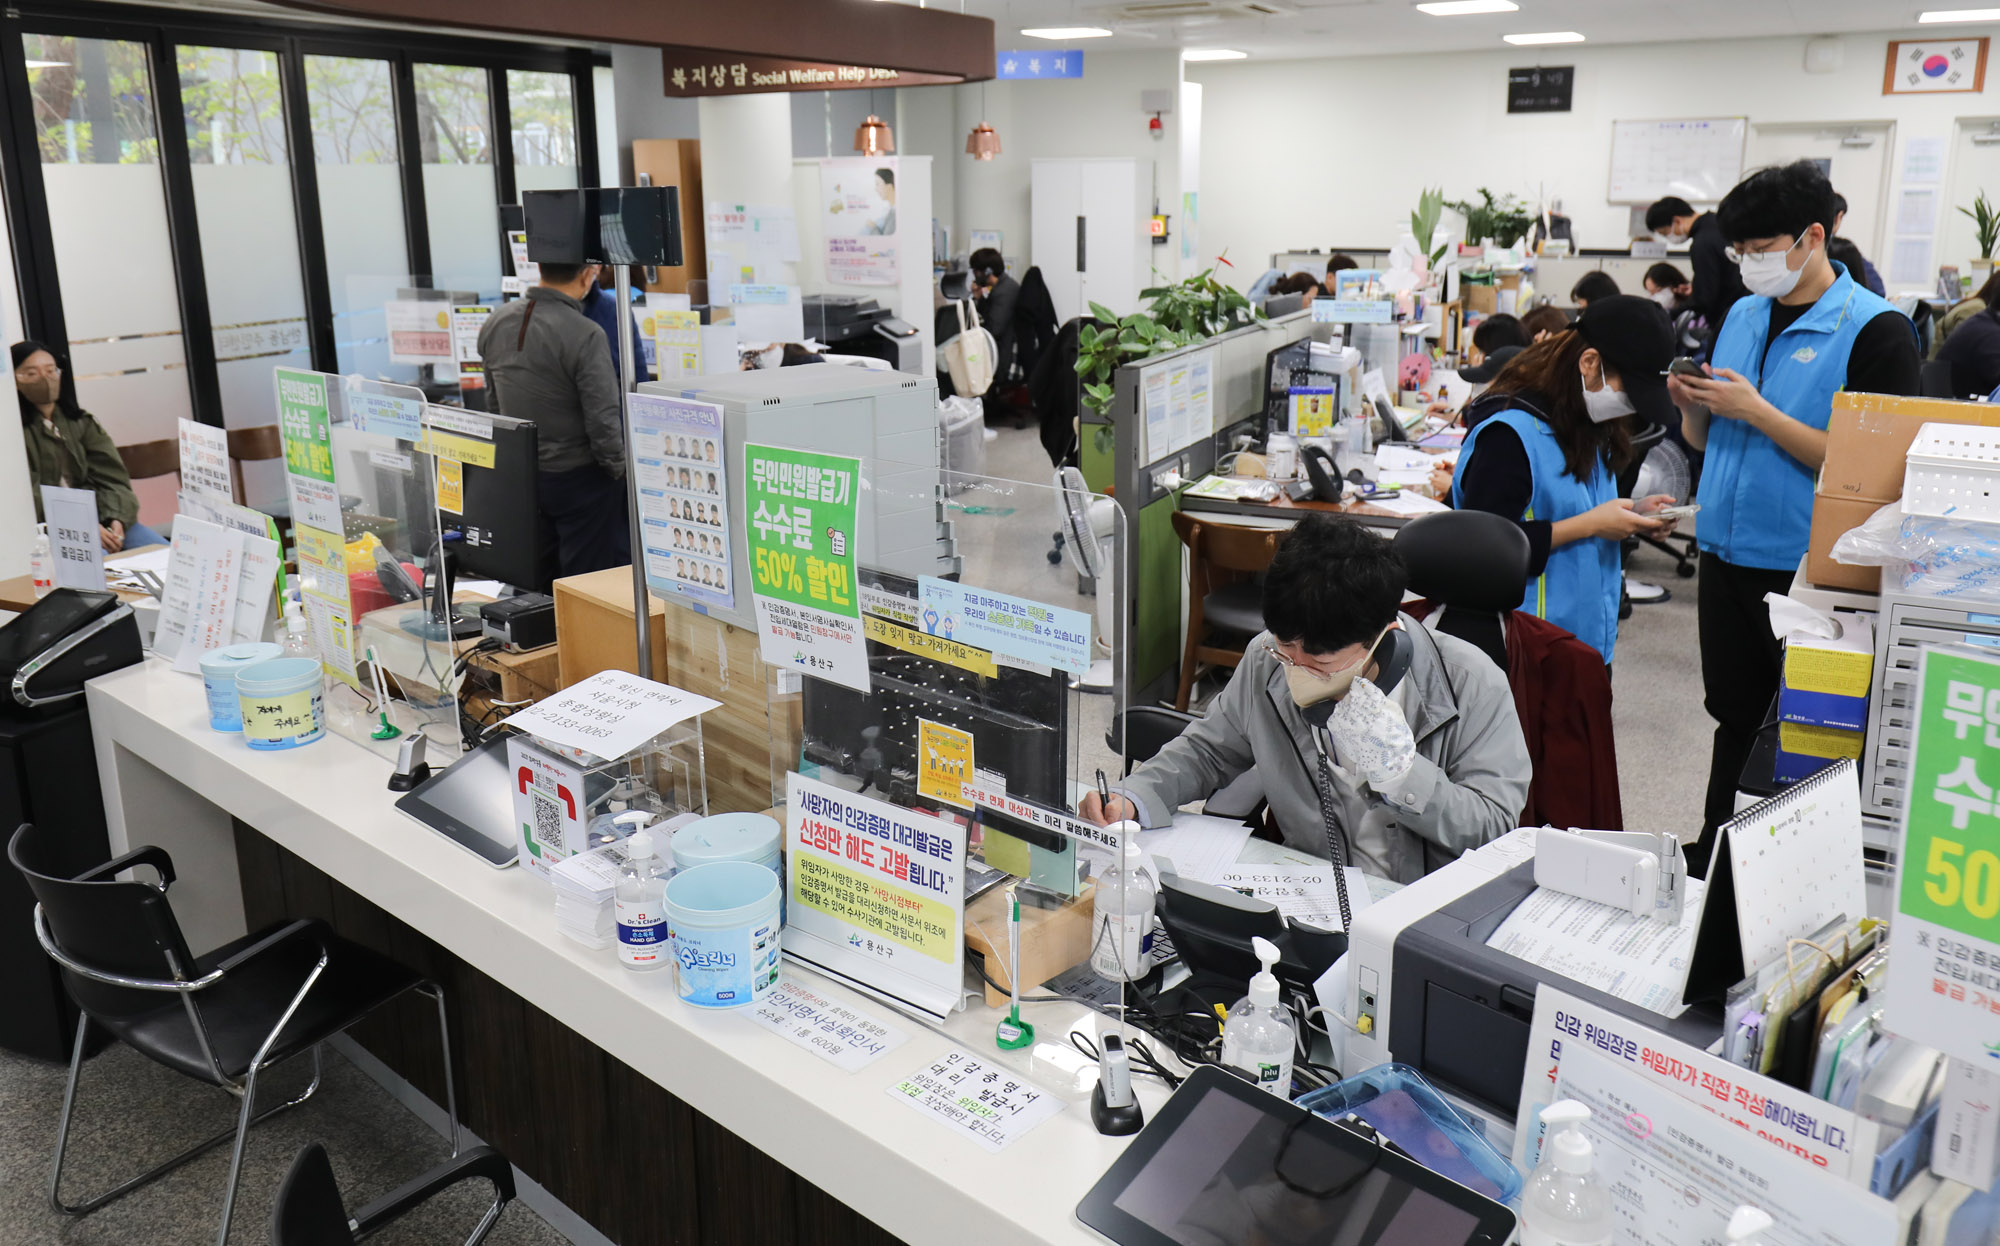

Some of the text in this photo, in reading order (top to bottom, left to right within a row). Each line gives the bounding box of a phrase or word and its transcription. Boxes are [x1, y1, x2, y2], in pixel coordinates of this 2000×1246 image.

[752, 70, 787, 86] Social
[789, 68, 835, 84] Welfare
[838, 66, 865, 82] Help
[284, 406, 312, 439] 수수료
[698, 410, 717, 427] 안내
[752, 458, 850, 506] 무인민원발급기
[752, 500, 814, 551] 수수료
[61, 546, 93, 563] 출입금지
[755, 546, 850, 606] 50% 할인
[767, 602, 800, 619] 인감증명서,
[964, 592, 1054, 624] 지금 마주하고 있는 직원은
[964, 606, 986, 621] 우리의
[987, 610, 1015, 628] 소중한
[1016, 617, 1042, 635] 가족일
[1043, 625, 1052, 637] 수
[1053, 629, 1086, 646] 있습니다
[810, 624, 853, 644] 민원창구에서만
[872, 620, 886, 636] 도장
[890, 626, 904, 642] 잊지
[908, 632, 924, 646] 말고
[810, 655, 834, 671] 용산구
[274, 716, 301, 730] 주세요
[524, 706, 613, 739] 02-2133-0063
[1934, 756, 2000, 830] 수
[845, 806, 891, 841] 인감증명
[893, 822, 953, 863] 대리발급은
[962, 786, 1120, 849] 수수료 면제 대상자는 미리 말씀해주세요.
[799, 817, 843, 857] 신청만
[846, 832, 875, 868] 해도
[800, 859, 830, 878] 위임자가
[830, 869, 853, 889] 사망한
[854, 878, 870, 894] 경우
[643, 917, 661, 925] Clean
[800, 873, 946, 940] 인감증명서 발급을 대리신청하면 사문서 위조에
[800, 887, 926, 947] 해당할 수 있어 수사기관에 고발됩니다.
[866, 939, 894, 958] 용산구
[767, 991, 886, 1056] 인서명사실확인서
[779, 982, 888, 1038] 인감증명서와 효력이 동일한
[756, 1007, 785, 1025] 수수료
[792, 1026, 812, 1038] 1통
[811, 1036, 844, 1056] 600원
[1264, 1068, 1278, 1078] plu
[1555, 1011, 1582, 1038] 인감
[1584, 1023, 1638, 1062] 위임장은
[1640, 1047, 1698, 1087] 위임자가
[1700, 1072, 1731, 1102] 직접
[1734, 1085, 1850, 1154] 작성해야합니다.
[899, 1082, 923, 1098] 직접
[924, 1094, 969, 1122] 작성해야
[911, 1073, 1003, 1124] 위임장은 위임자가
[978, 1088, 1025, 1116] 발급시
